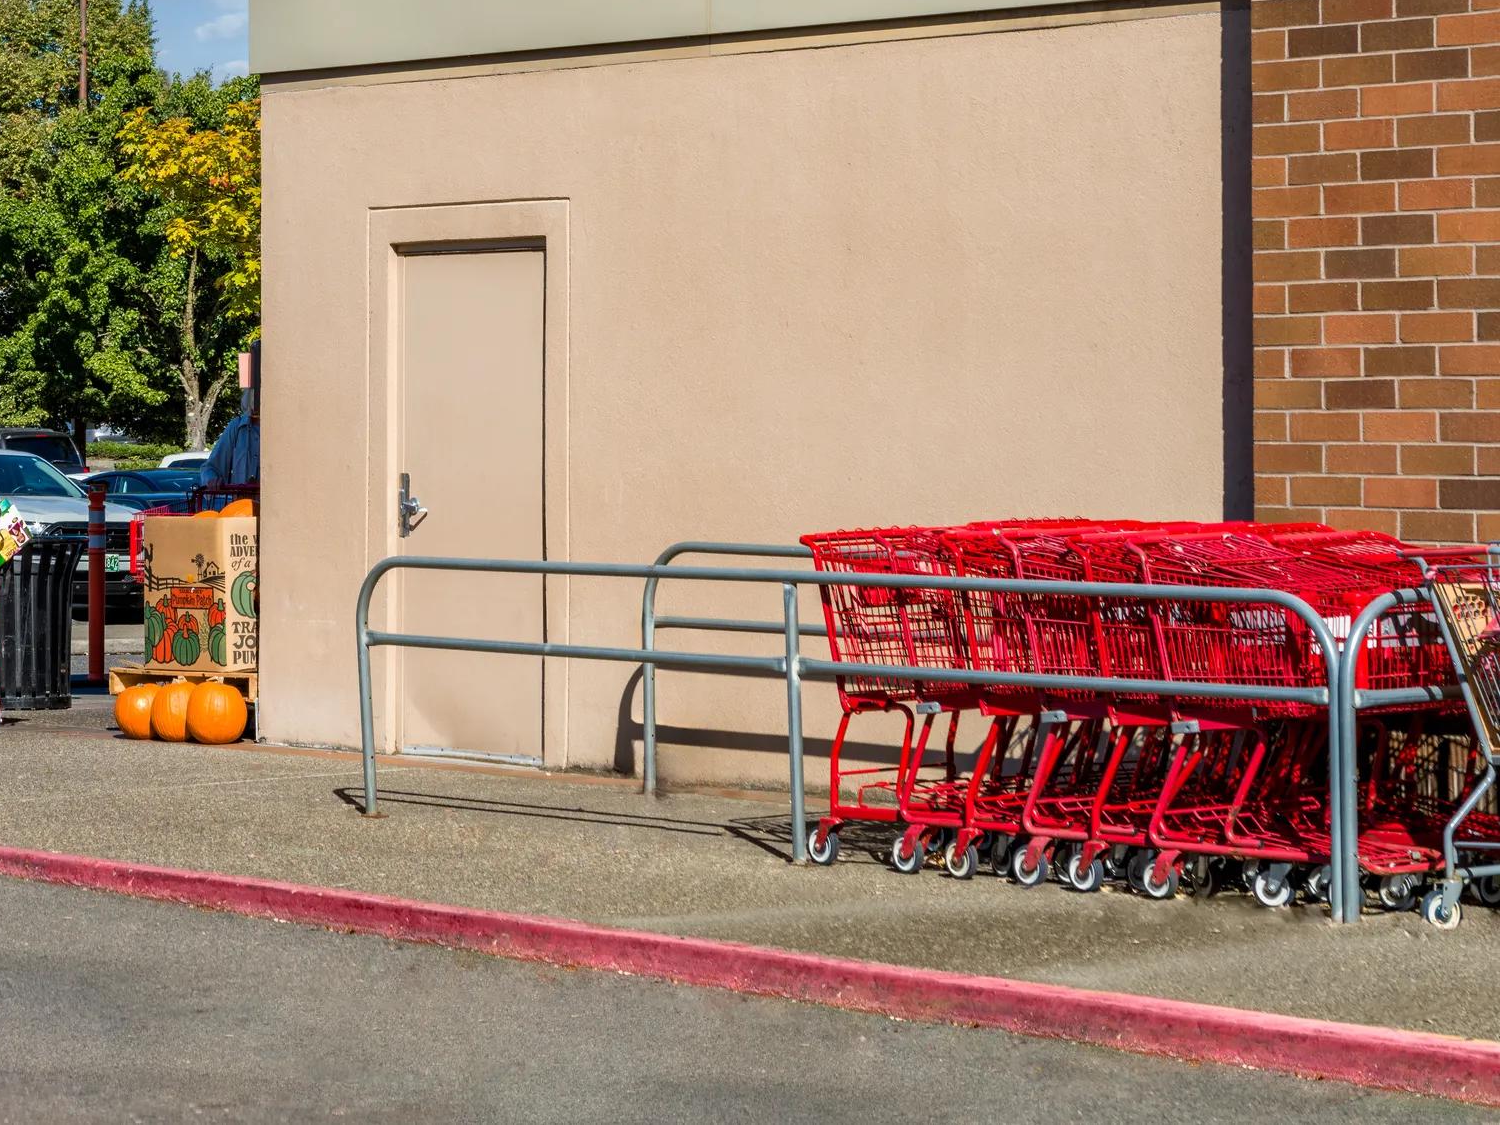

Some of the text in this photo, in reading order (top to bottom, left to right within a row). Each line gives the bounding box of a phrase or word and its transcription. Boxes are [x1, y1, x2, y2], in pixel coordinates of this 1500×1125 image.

[230, 533, 248, 545] the
[231, 557, 251, 571] of a
[171, 593, 213, 608] Pumpkin Patch
